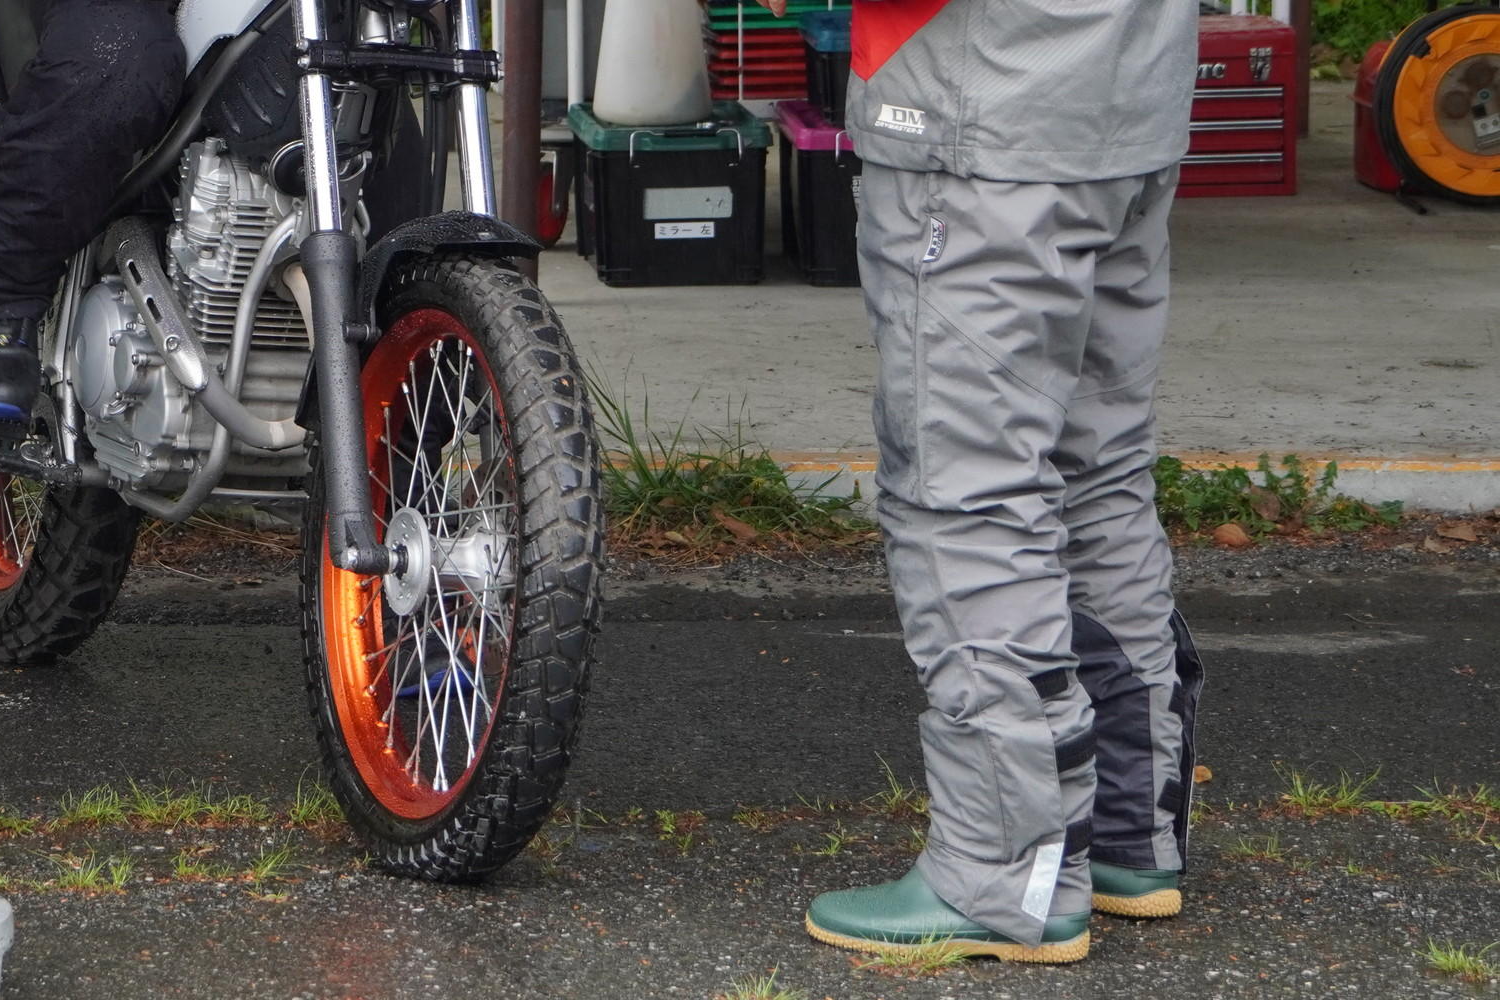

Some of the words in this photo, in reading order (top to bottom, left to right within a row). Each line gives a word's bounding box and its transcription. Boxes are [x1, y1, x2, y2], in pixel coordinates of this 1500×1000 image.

[660, 225, 692, 235] ミラー
[701, 224, 711, 235] 左
